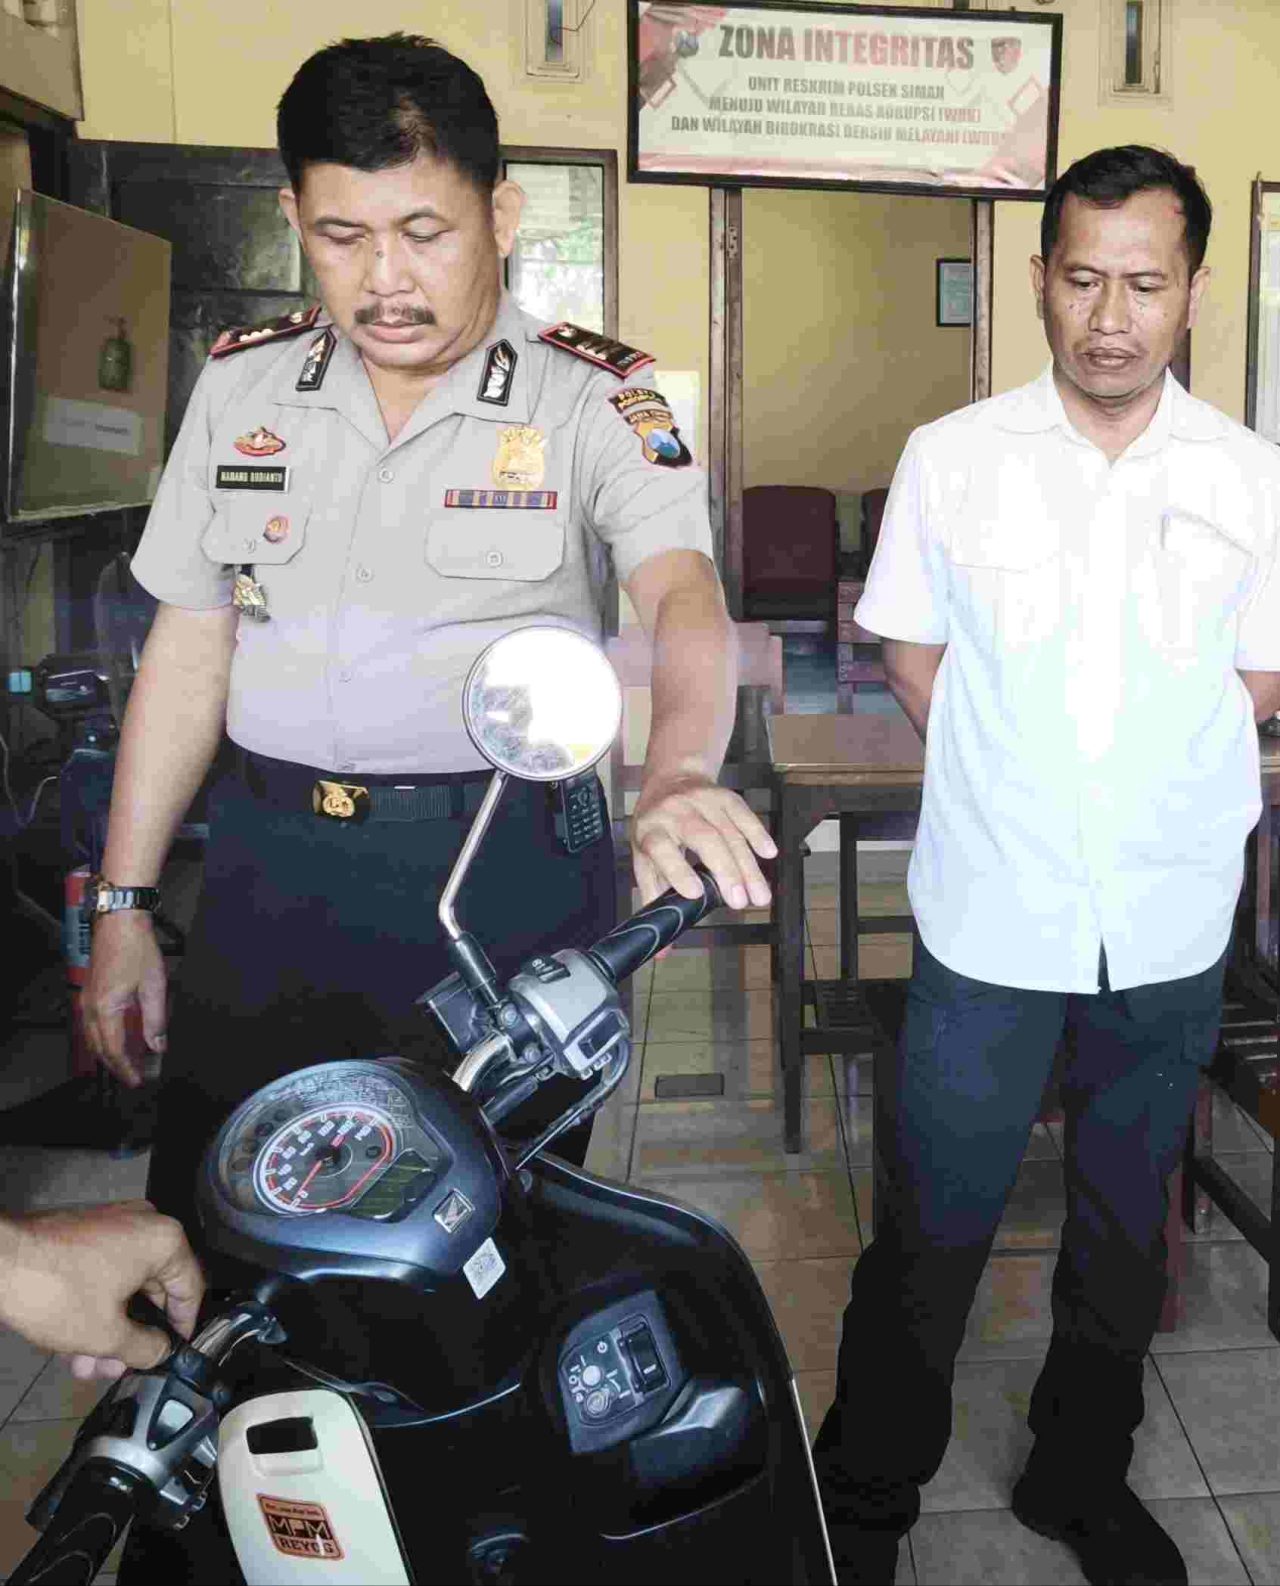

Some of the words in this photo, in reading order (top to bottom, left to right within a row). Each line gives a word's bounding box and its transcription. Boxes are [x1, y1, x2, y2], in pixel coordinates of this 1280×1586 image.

[719, 24, 795, 61] ZONA
[803, 28, 974, 69] INTEGRITAS
[748, 76, 779, 92] UNIT
[783, 78, 845, 95] RESKRIM
[848, 81, 898, 98] POLSEK
[766, 99, 826, 115] WILAYAH
[671, 116, 699, 131] DAN
[702, 117, 763, 135] WILAYAH
